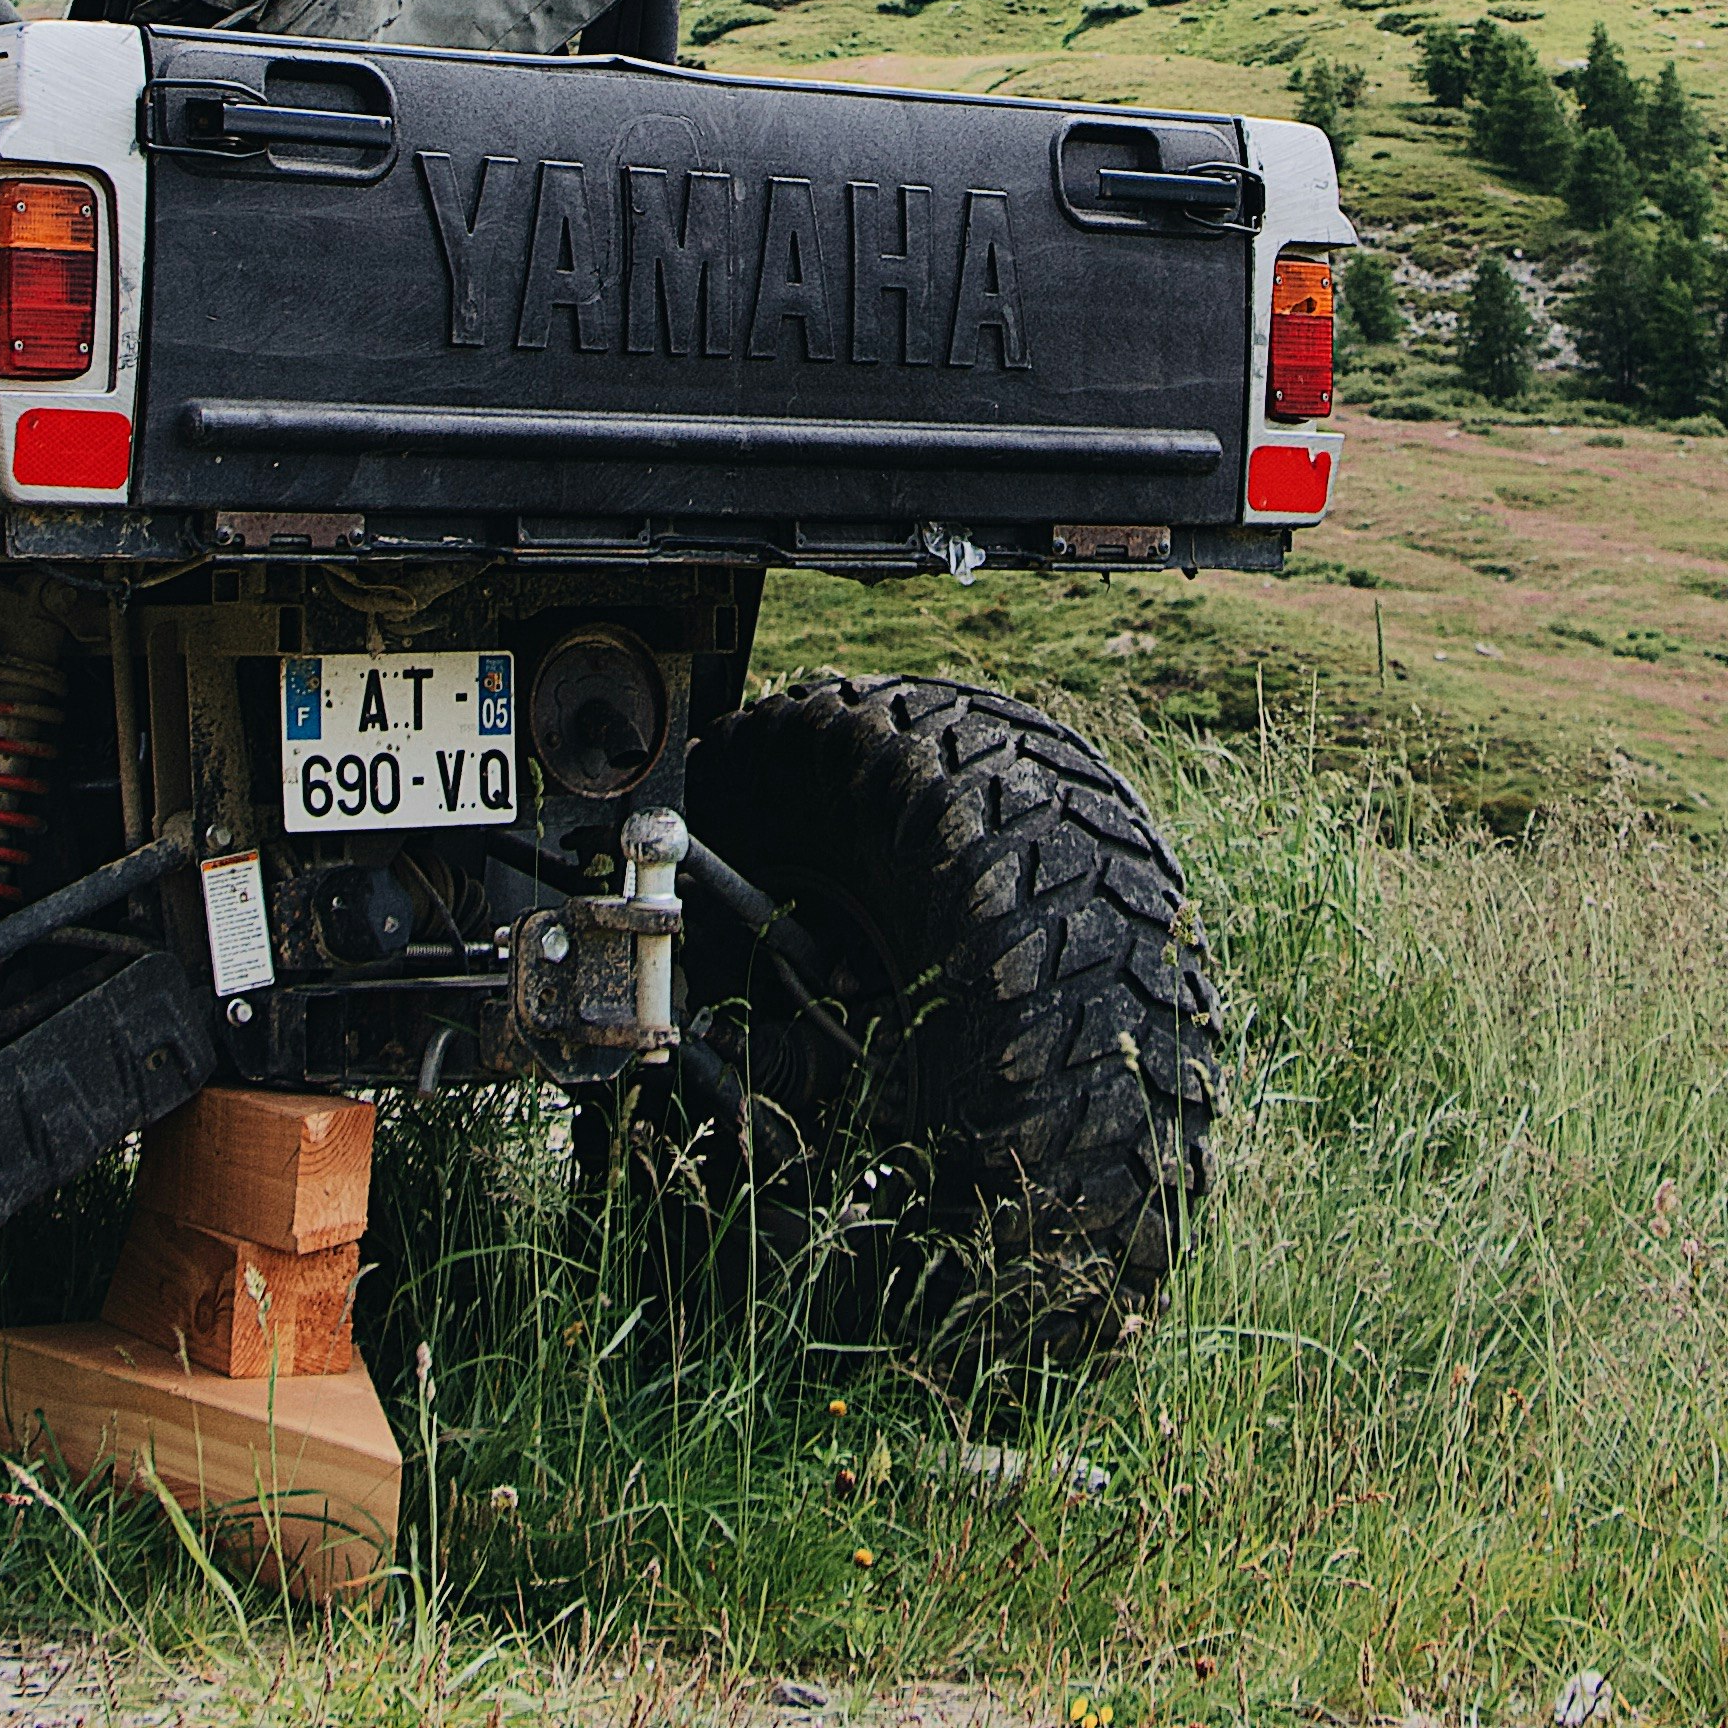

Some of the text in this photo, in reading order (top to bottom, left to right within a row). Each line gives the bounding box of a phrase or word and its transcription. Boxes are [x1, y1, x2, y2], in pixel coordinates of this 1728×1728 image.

[415, 151, 1032, 369] YAMAHA
[297, 707, 311, 727] F
[481, 698, 509, 729] 05
[301, 748, 514, 818] 690-VQ
